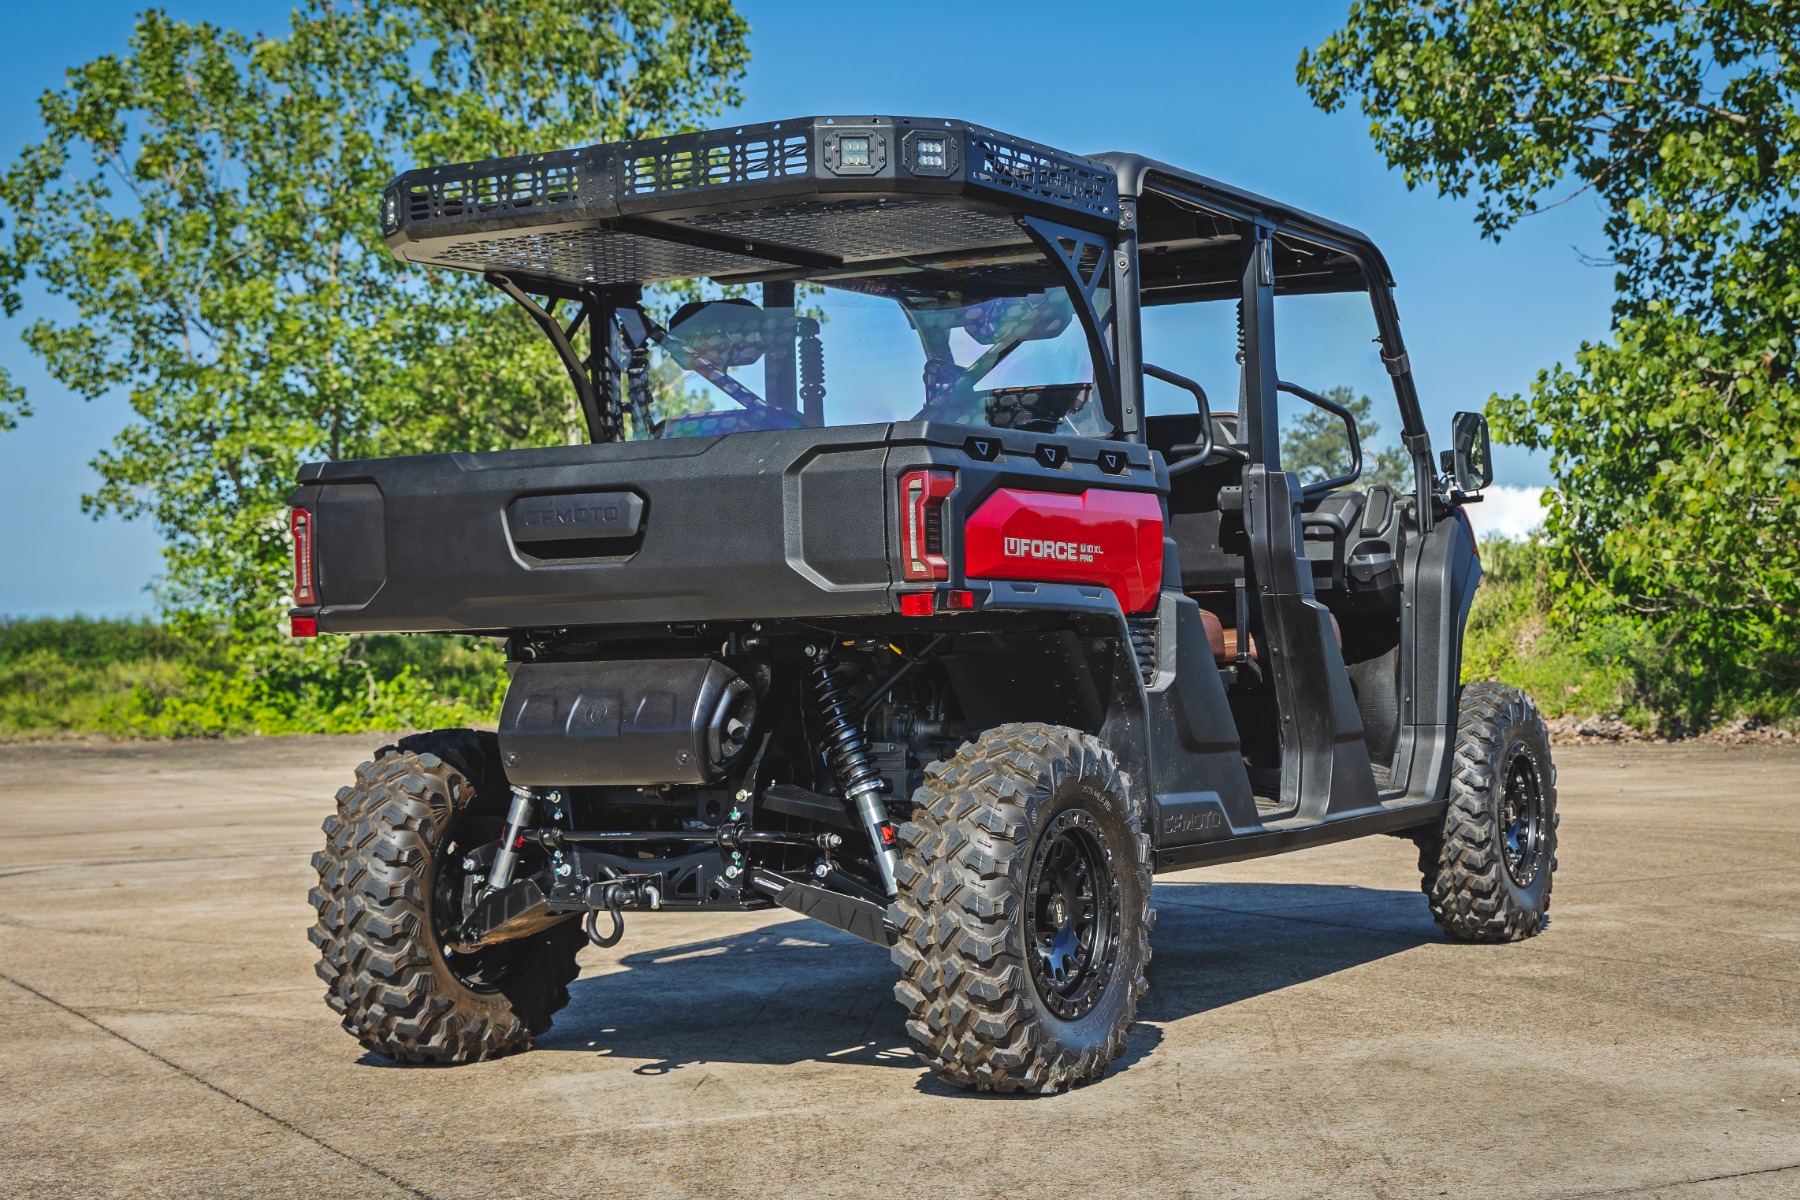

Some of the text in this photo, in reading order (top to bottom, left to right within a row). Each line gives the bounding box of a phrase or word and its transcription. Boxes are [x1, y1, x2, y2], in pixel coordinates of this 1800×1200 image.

[525, 505, 619, 526] CFMOTO
[1004, 537, 1078, 561] UFORCE
[1080, 554, 1094, 563] PRO
